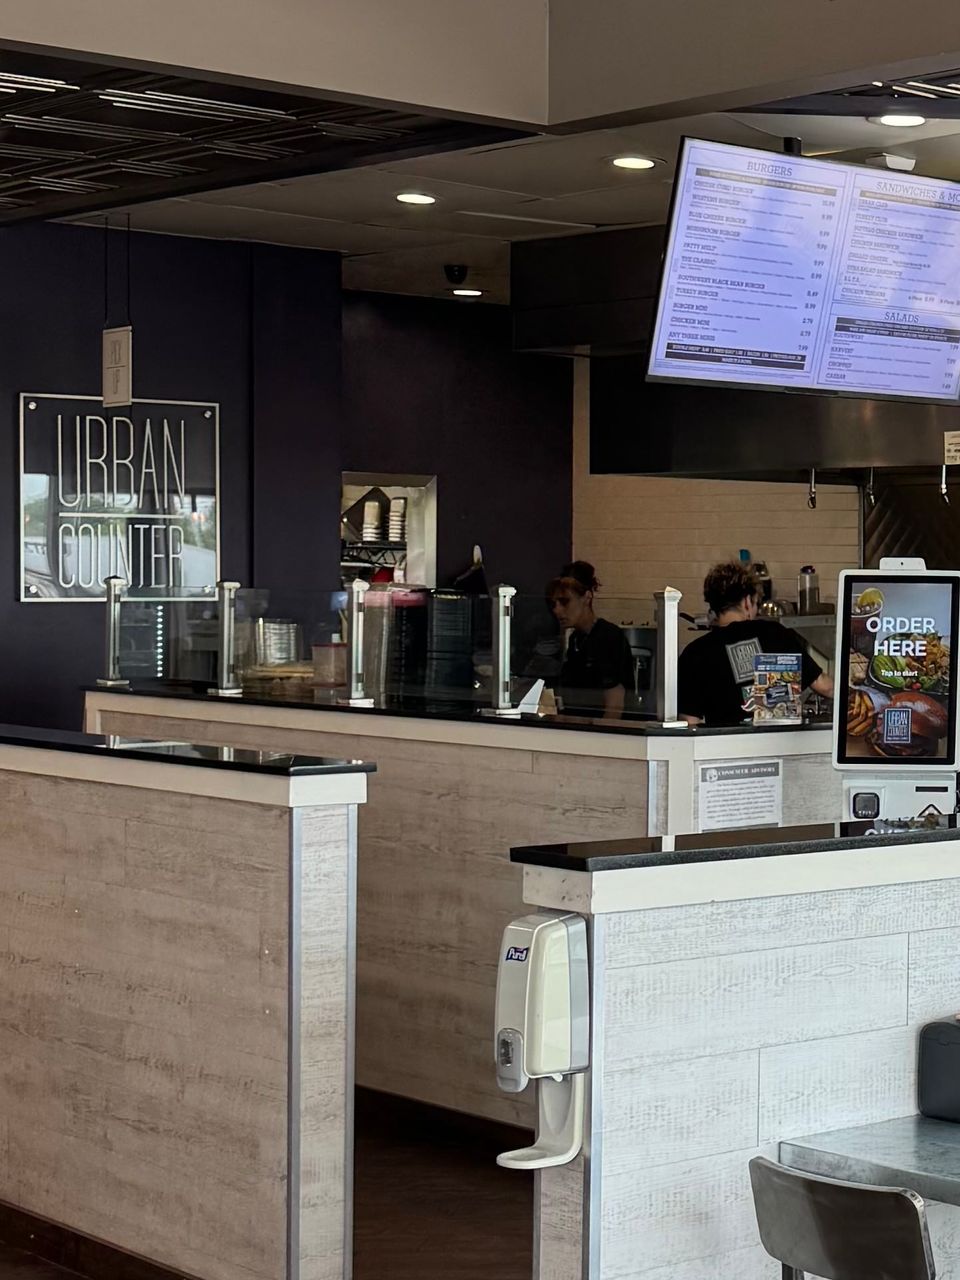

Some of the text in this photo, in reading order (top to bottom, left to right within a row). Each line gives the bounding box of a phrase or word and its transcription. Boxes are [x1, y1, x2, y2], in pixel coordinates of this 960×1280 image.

[746, 161, 793, 177] BURGERS
[875, 181, 938, 200] SANDWICHES
[939, 191, 946, 200] &
[884, 311, 920, 324] SALADS
[57, 413, 186, 509] URBAN
[58, 522, 185, 589] COUNTER
[866, 616, 936, 633] ORDER
[873, 640, 928, 657] HERE
[880, 669, 893, 678] Tap
[894, 669, 902, 677] to
